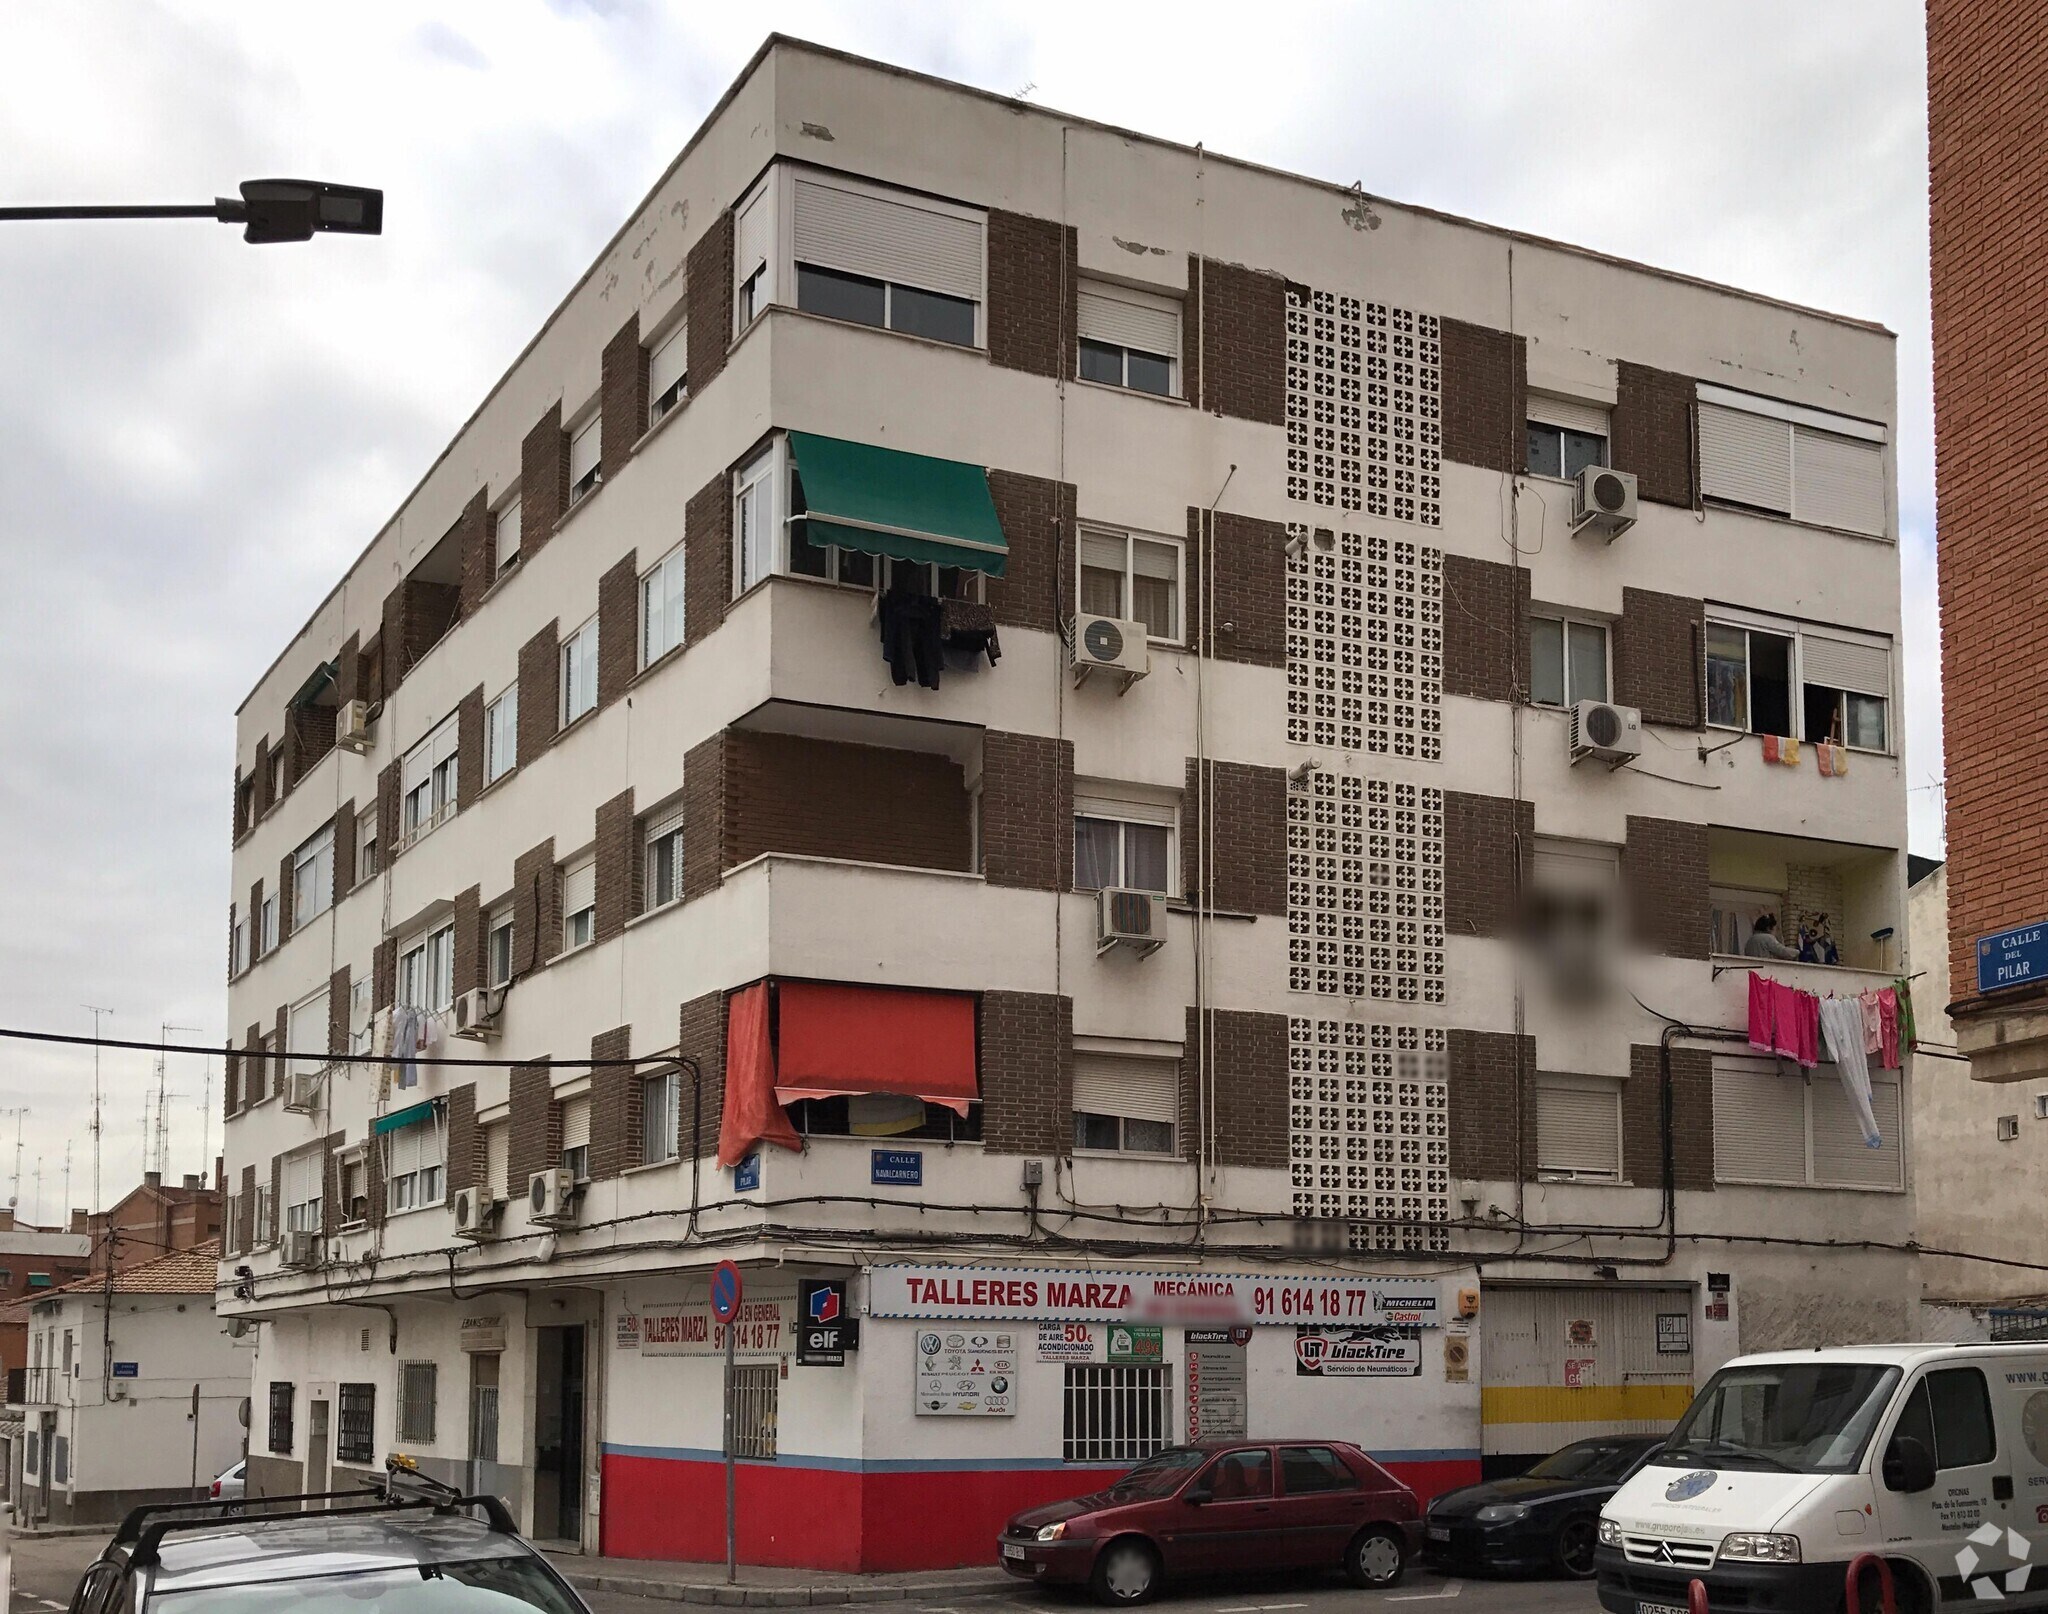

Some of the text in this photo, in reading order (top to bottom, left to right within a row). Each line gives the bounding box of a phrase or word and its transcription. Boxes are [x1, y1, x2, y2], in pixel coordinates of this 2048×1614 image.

[2001, 930, 2041, 949] CALLE
[2005, 950, 2022, 961] DEL
[1997, 961, 2031, 981] PILAR
[889, 1156, 916, 1164] CALLE
[875, 1169, 919, 1180] NAVALCARNERO
[906, 1278, 1134, 1309] TALLERES MARZA
[1154, 1280, 1235, 1297] MECÁNICA
[1254, 1287, 1275, 1315] 91
[1281, 1288, 1314, 1316] 614
[1320, 1289, 1341, 1316] 18
[1346, 1290, 1367, 1317] 77
[1386, 1299, 1434, 1307] MICHELIN
[754, 1304, 780, 1321] GENERAL
[1394, 1312, 1422, 1321] Castrol
[644, 1317, 680, 1342] TALLERES
[681, 1316, 708, 1342] MARZA
[1038, 1323, 1061, 1331] CARGA
[714, 1323, 780, 1349] 91 14 18 77
[809, 1331, 839, 1349] elf
[1038, 1333, 1064, 1341] DE AIRE
[1190, 1331, 1228, 1340] blackTire
[1038, 1343, 1094, 1351] ACONDICIONADO
[1330, 1344, 1406, 1359] blackTire
[1327, 1365, 1408, 1373] Servicio de Neumáticos
